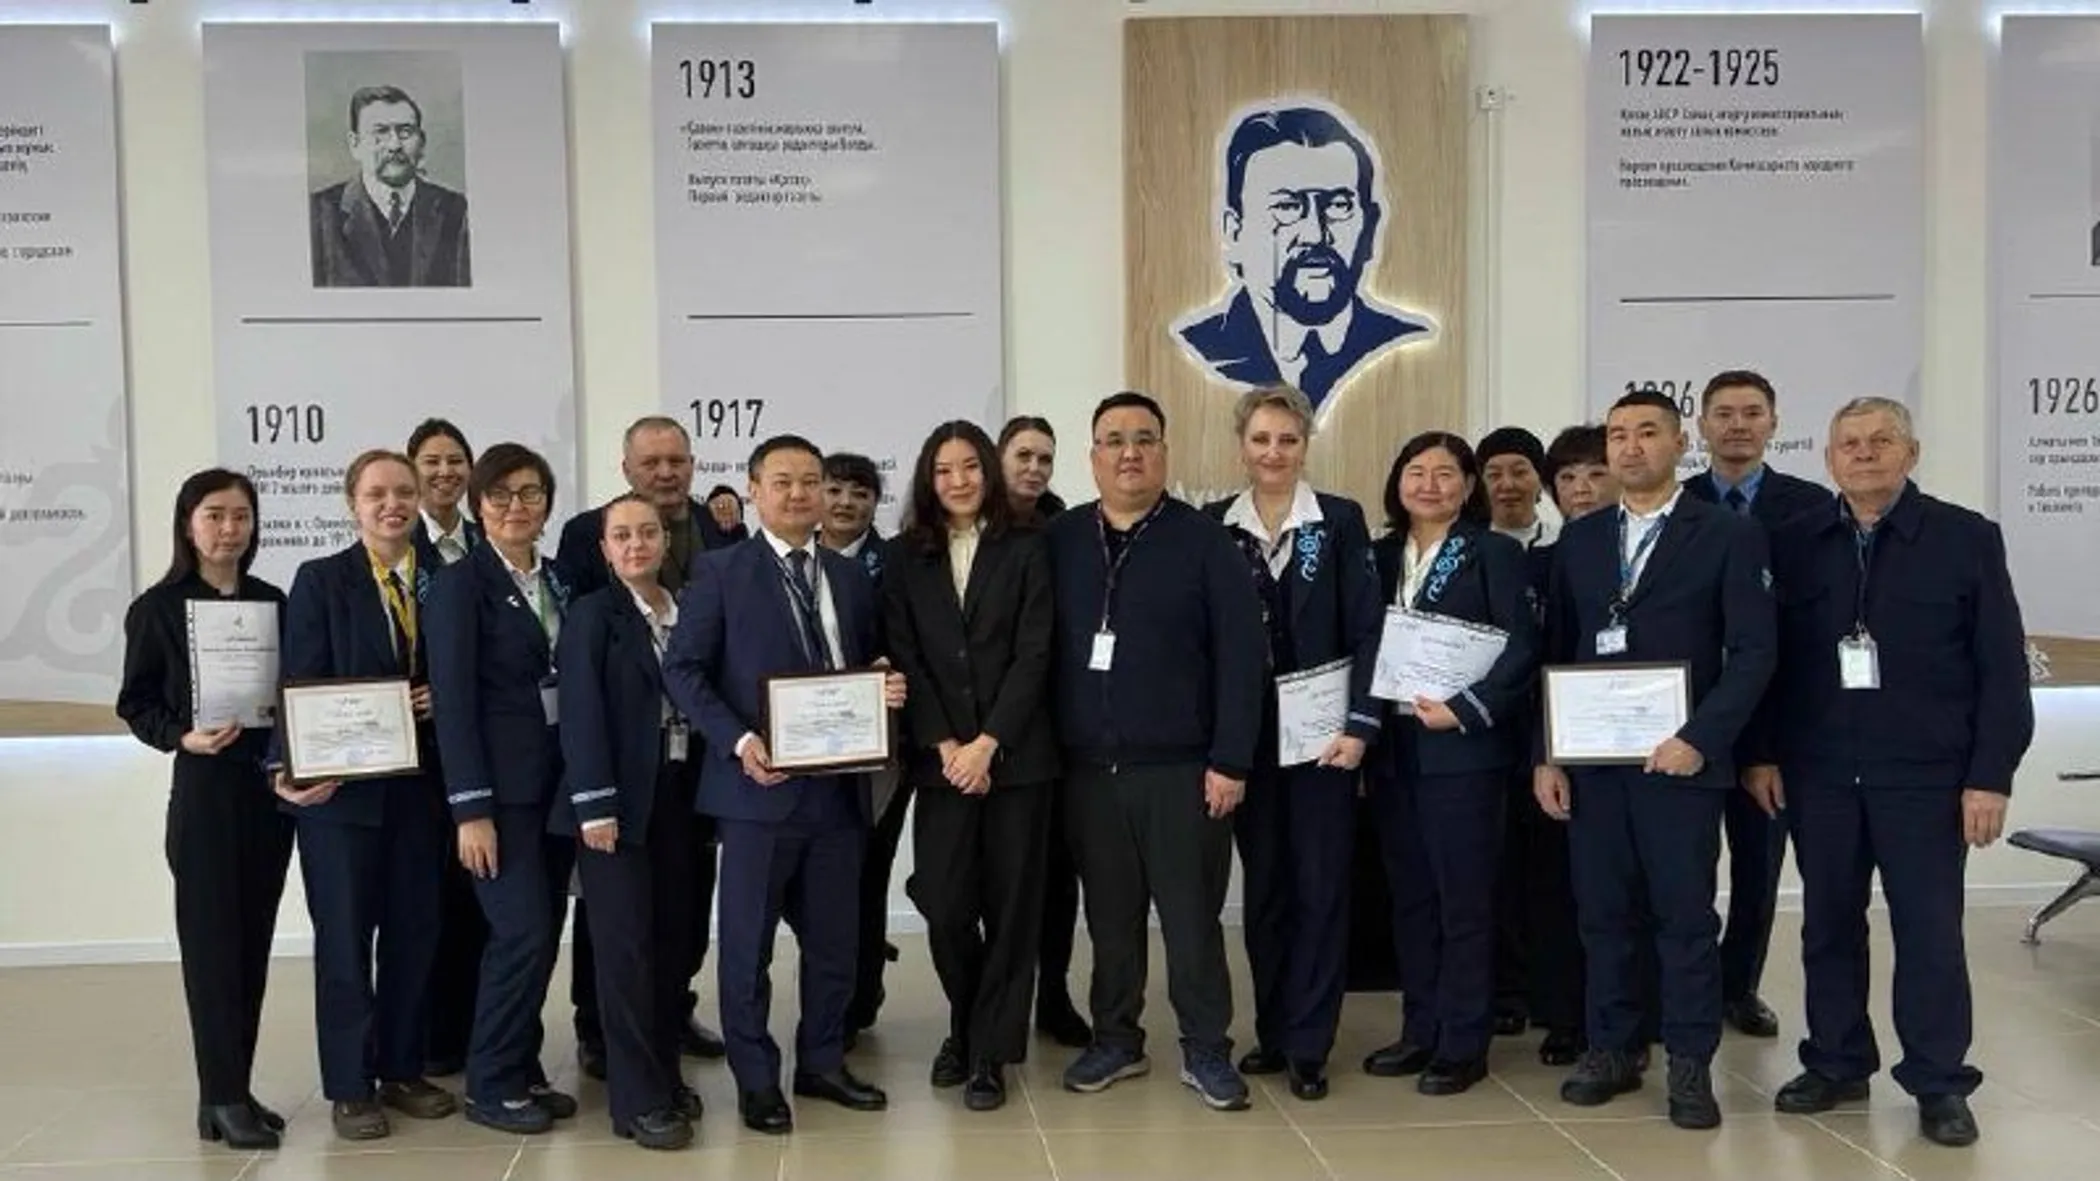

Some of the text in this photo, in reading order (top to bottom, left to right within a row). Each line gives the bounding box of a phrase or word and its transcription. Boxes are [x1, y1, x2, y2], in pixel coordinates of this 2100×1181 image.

[680, 60, 755, 98] 1913
[1619, 49, 1778, 86] 1922-1925
[2029, 377, 2098, 415] 1926
[247, 404, 324, 444] 1910
[690, 399, 763, 438] 1917
